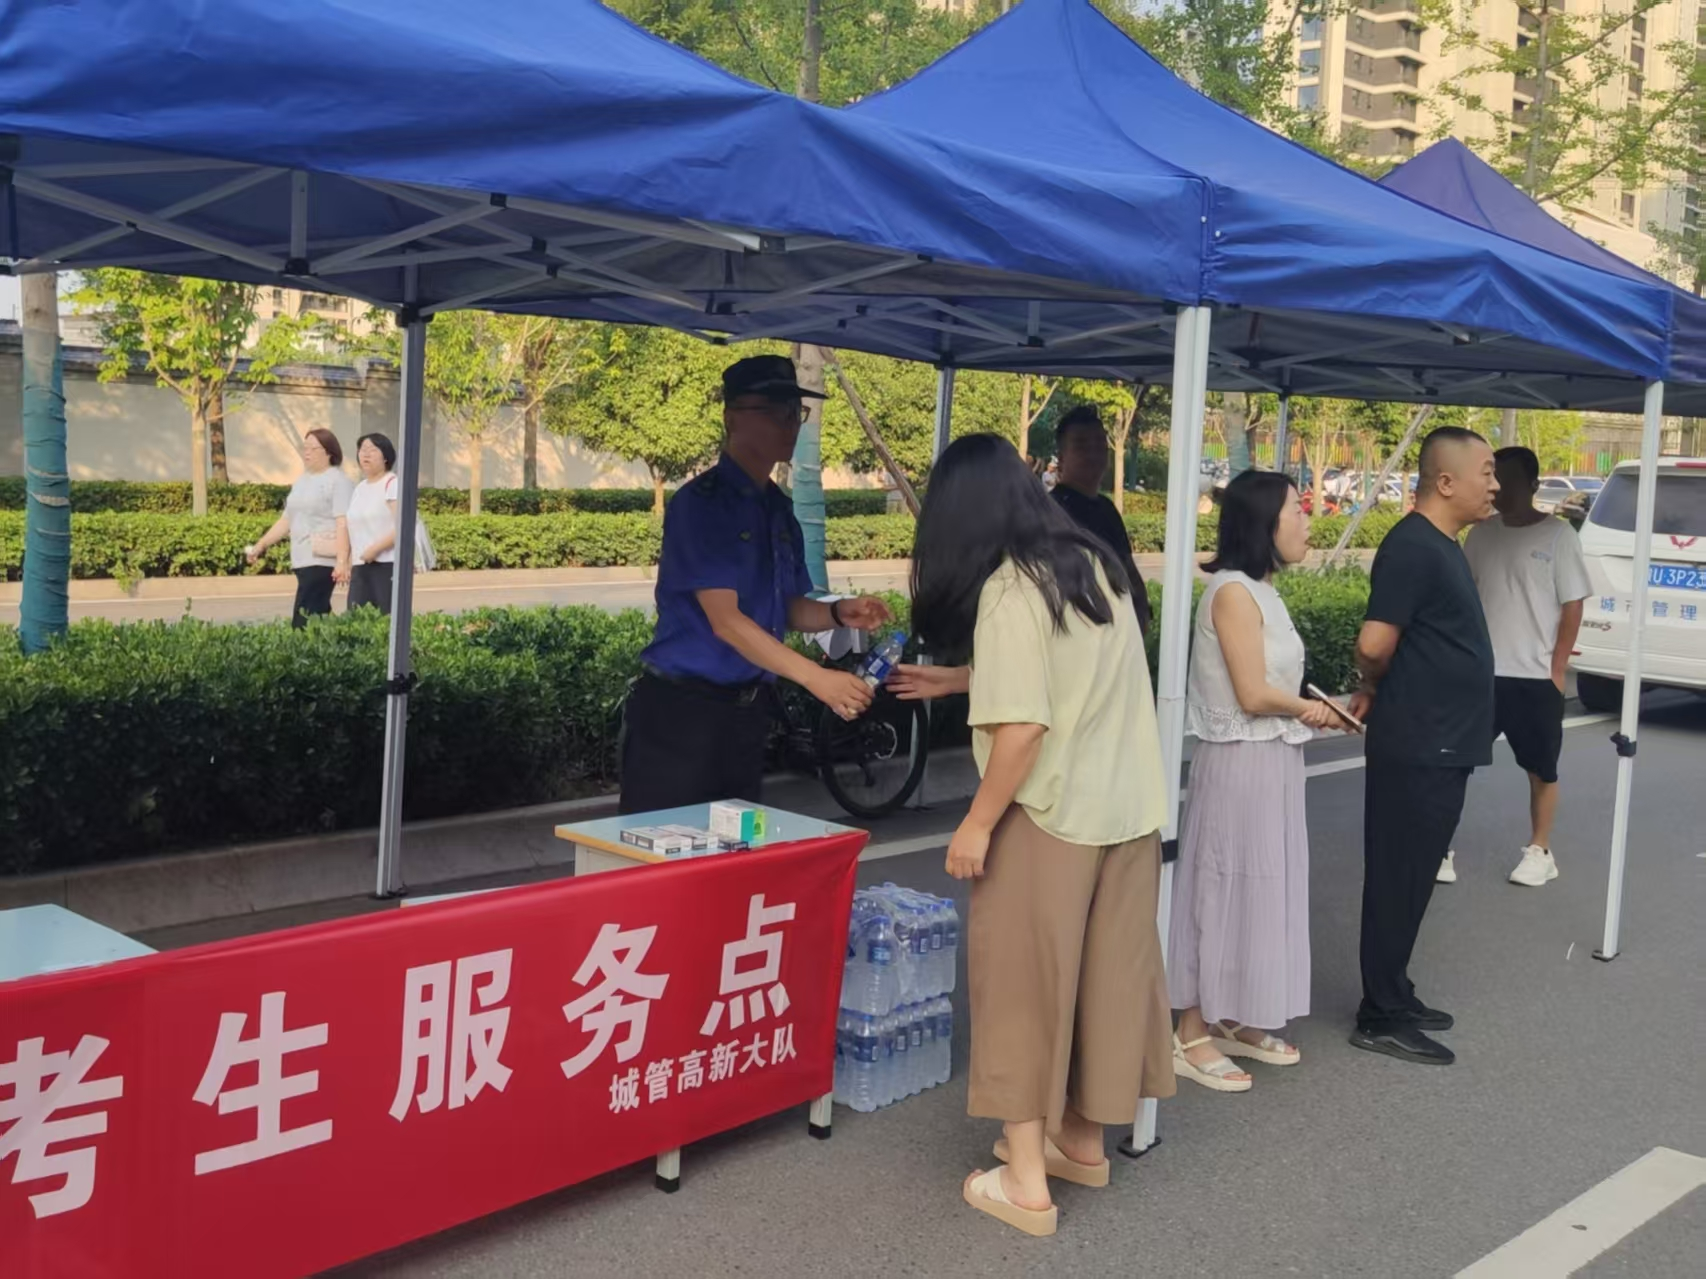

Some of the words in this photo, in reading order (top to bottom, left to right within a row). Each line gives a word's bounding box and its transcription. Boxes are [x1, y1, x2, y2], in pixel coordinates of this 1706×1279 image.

[0, 894, 797, 1219] 考生服务点
[608, 1023, 797, 1114] 城管高新大队
